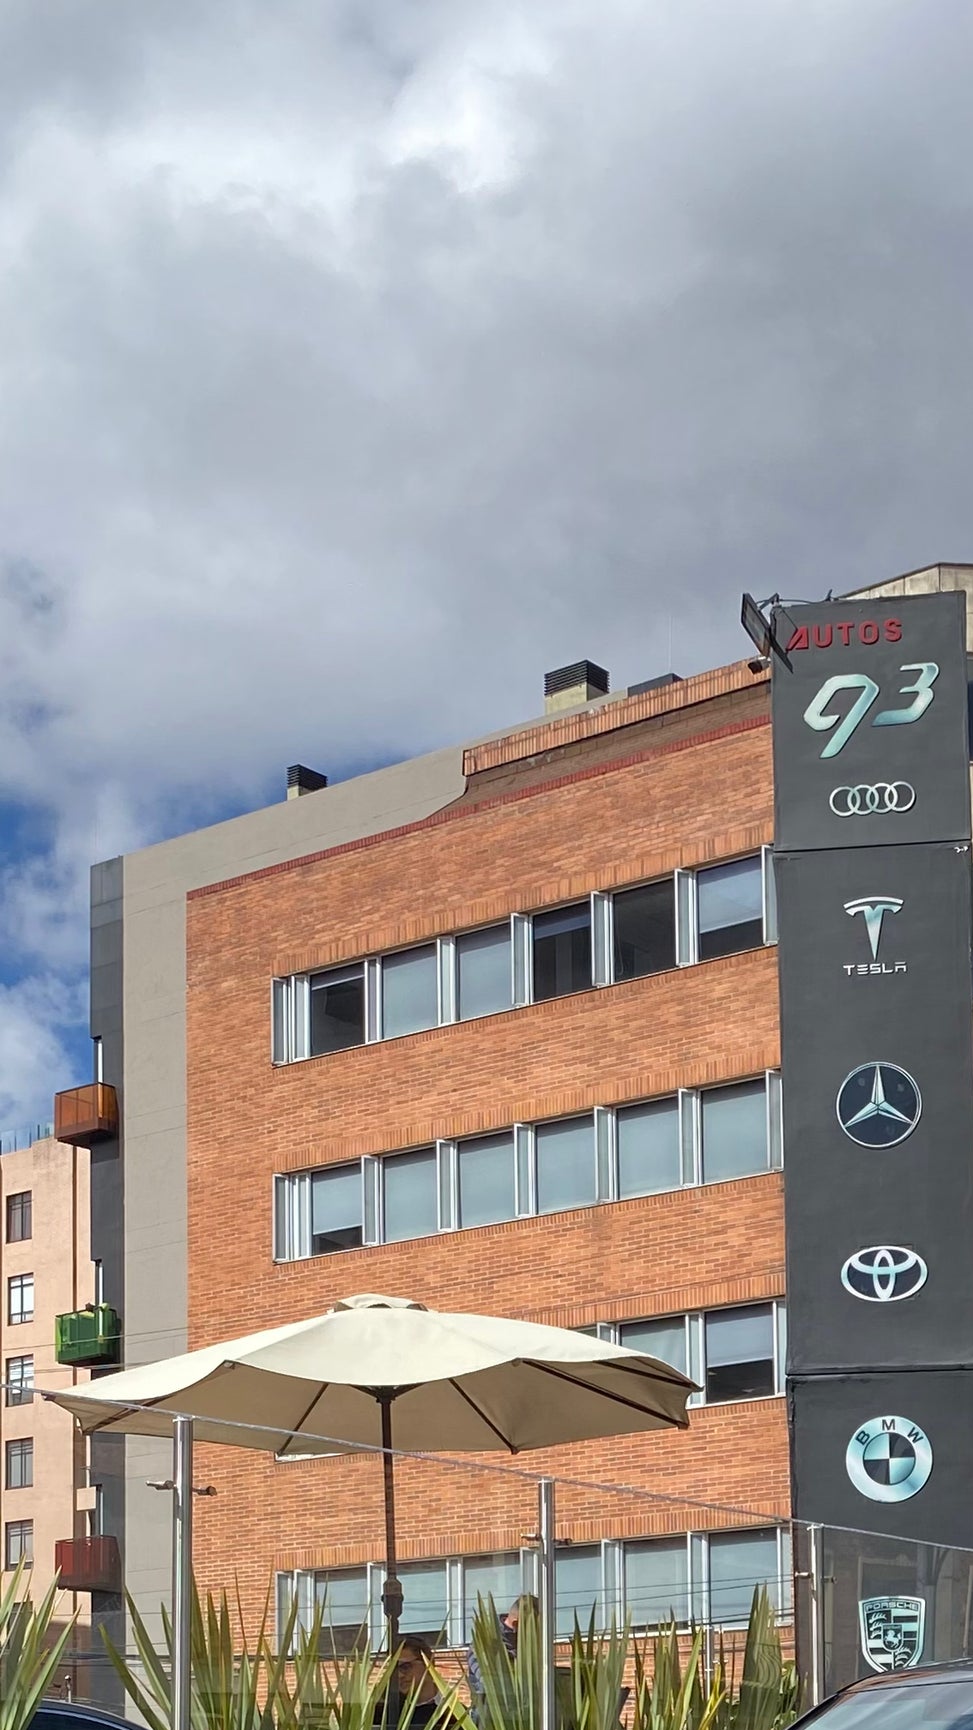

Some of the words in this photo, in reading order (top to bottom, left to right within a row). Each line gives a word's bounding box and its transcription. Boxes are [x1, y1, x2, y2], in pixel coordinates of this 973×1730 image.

[785, 618, 903, 651] AUTOS
[803, 661, 940, 760] 93
[843, 961, 908, 976] TESLA
[855, 1418, 924, 1445] BMW
[865, 1601, 919, 1612] PORSCHE
